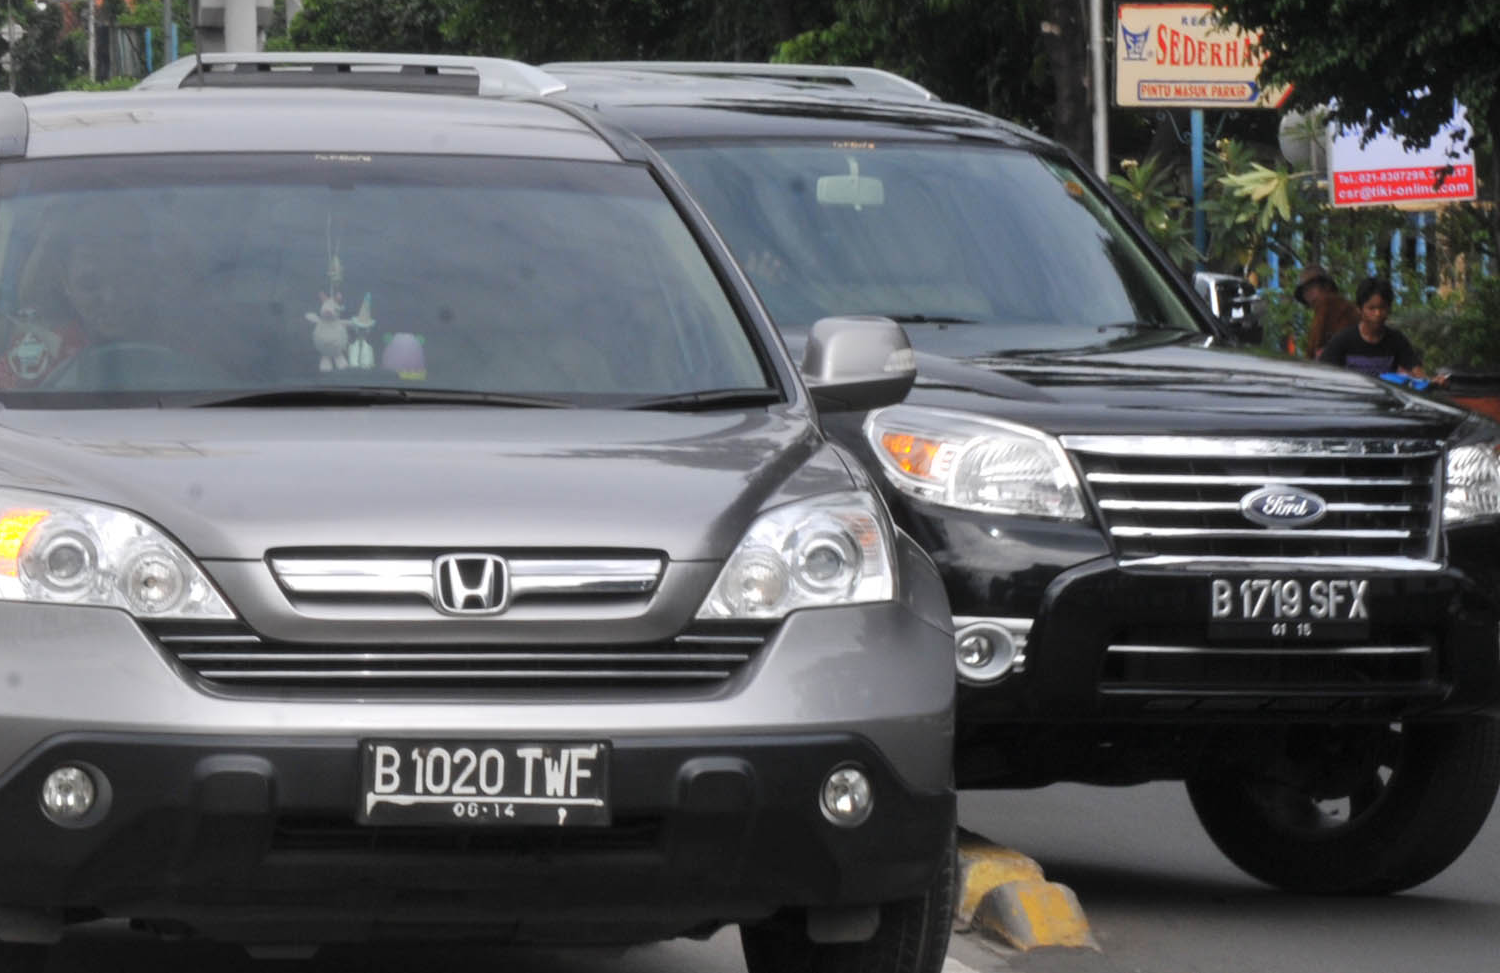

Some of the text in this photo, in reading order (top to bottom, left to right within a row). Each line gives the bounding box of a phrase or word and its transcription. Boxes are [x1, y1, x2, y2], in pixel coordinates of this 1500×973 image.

[1156, 24, 1269, 67] SEDERHA
[1141, 83, 1246, 98] PINTU MASUK PARKIR
[1263, 494, 1308, 516] Ford
[1212, 580, 1368, 619] B 1719 SFX
[375, 745, 598, 797] B 1020 TWF
